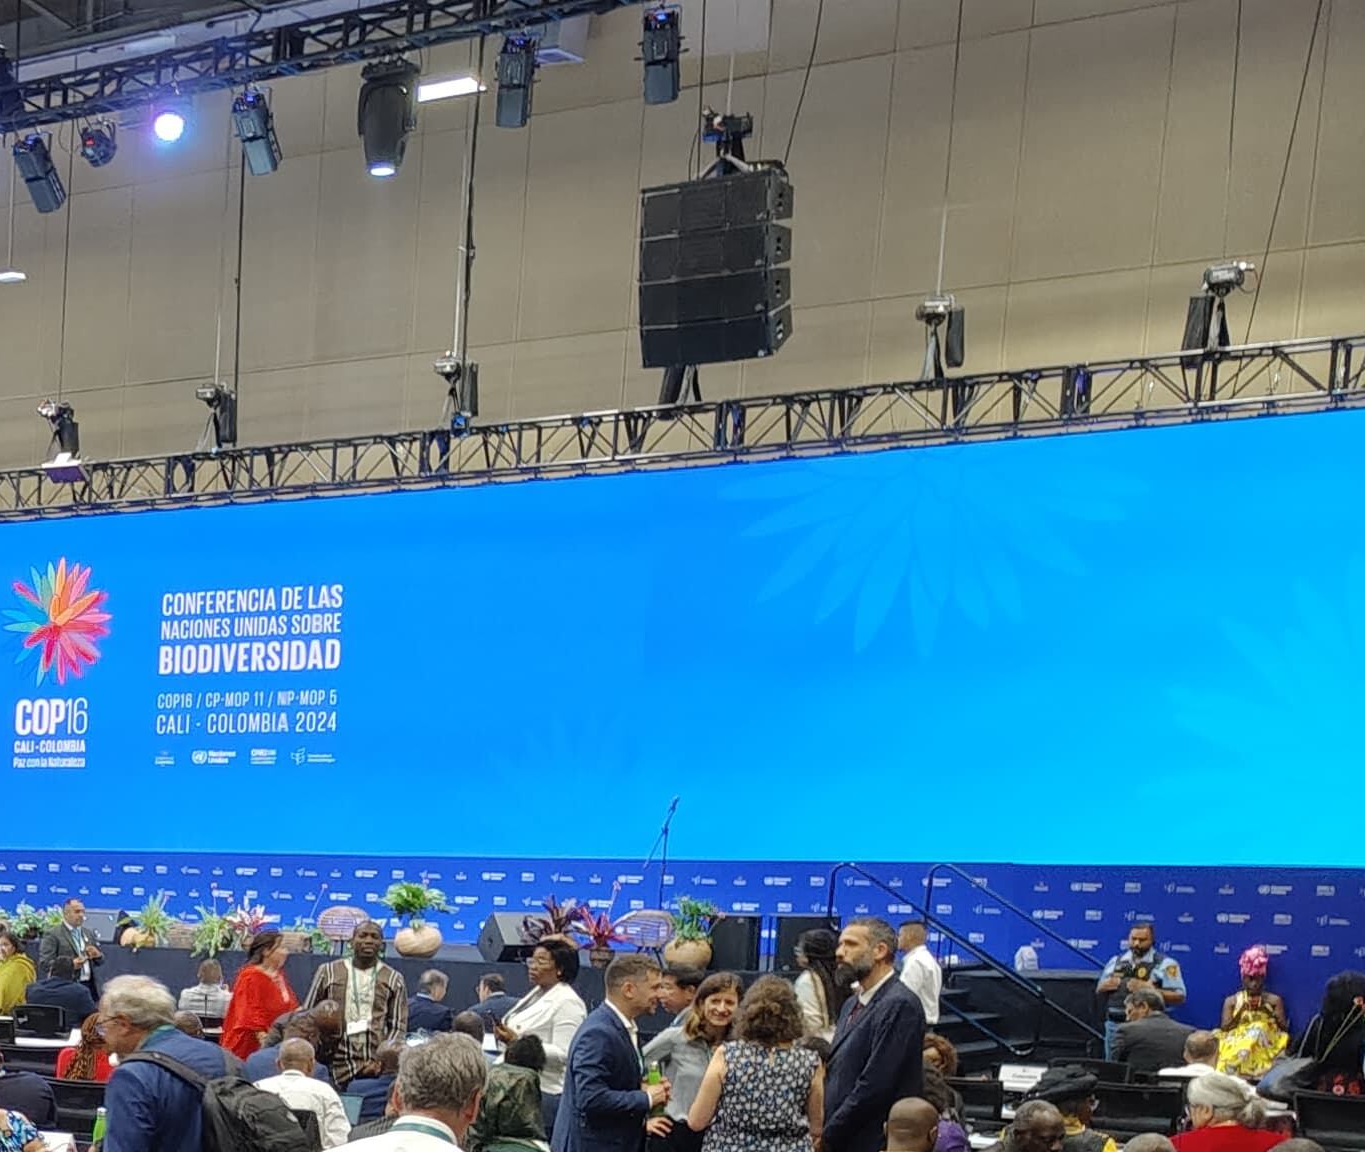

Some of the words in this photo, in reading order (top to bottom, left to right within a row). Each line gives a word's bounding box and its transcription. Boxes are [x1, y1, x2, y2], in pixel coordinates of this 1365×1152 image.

[162, 588, 274, 616] CONFERENCIA
[280, 587, 303, 611] DE
[307, 584, 344, 610] LAS
[160, 617, 230, 641] NACIONES
[233, 615, 287, 638] UNIDAS
[292, 612, 342, 635] SOBRE
[158, 638, 341, 675] BIODIVERSIDAD
[157, 693, 193, 709] COP16
[254, 691, 264, 706] 11
[14, 697, 88, 736] COP16
[156, 713, 191, 734] CALI
[207, 712, 289, 734] COLOMBIA
[295, 711, 337, 732] 2024
